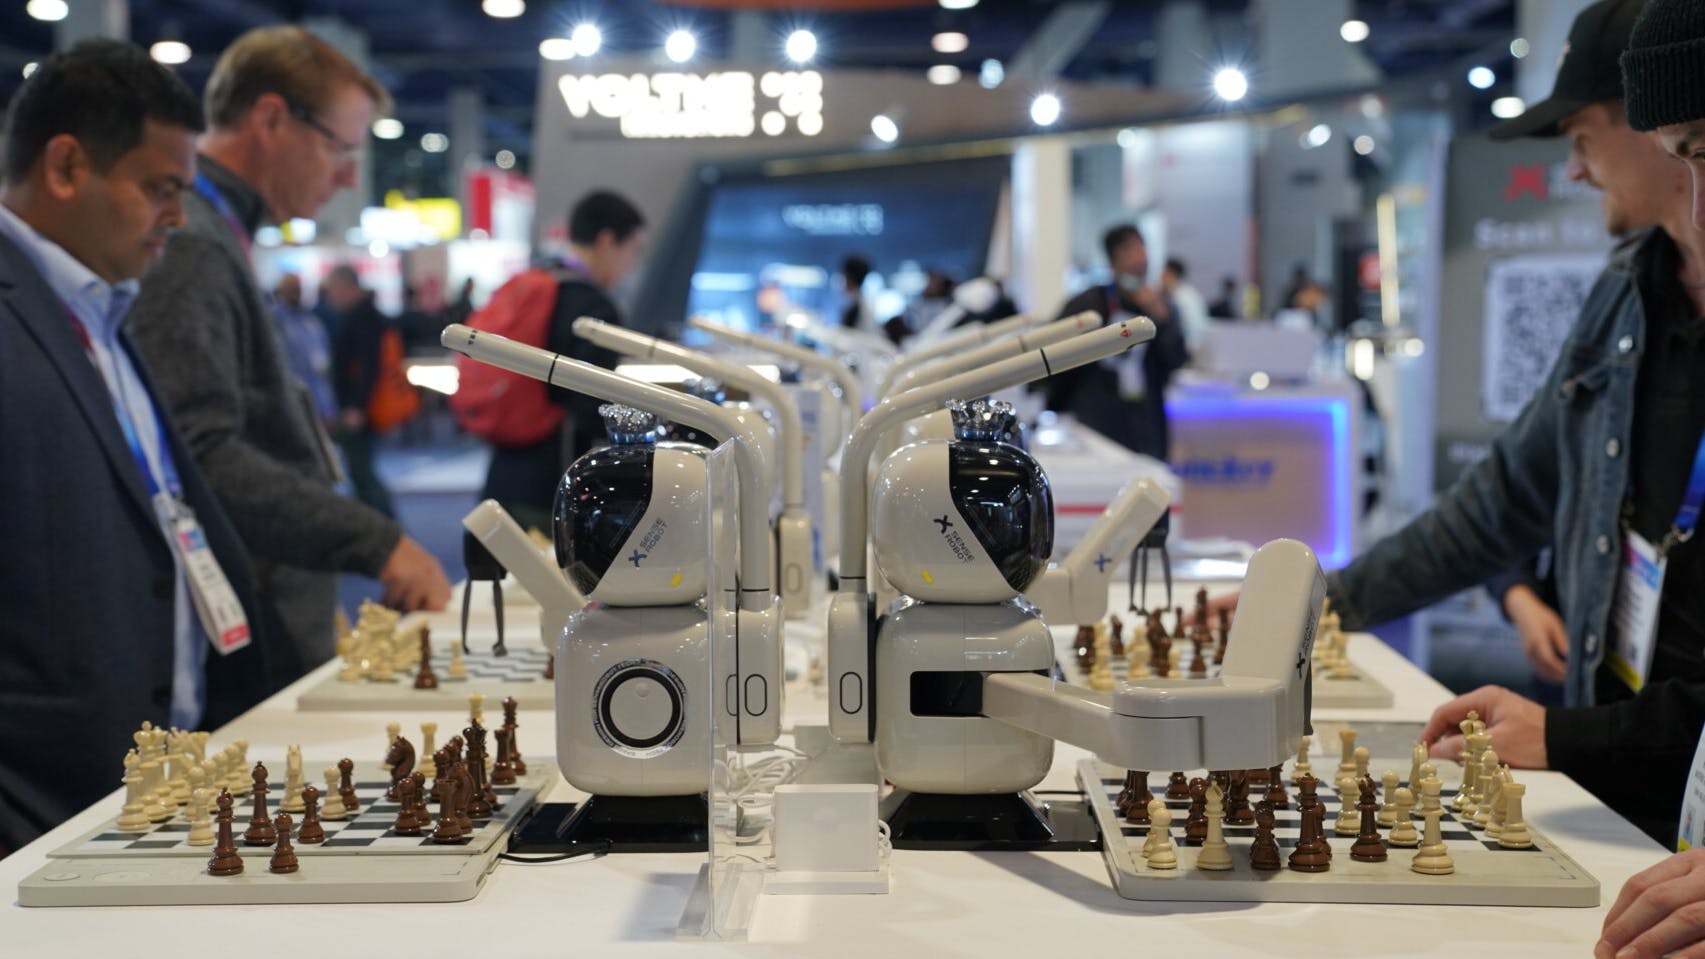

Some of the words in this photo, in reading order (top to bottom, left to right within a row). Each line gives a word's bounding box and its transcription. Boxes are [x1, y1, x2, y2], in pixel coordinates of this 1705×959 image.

[640, 518, 664, 548] SENSE
[645, 522, 668, 552] ROBOT
[951, 531, 975, 560] SENSE
[945, 534, 969, 563] ROBOT
